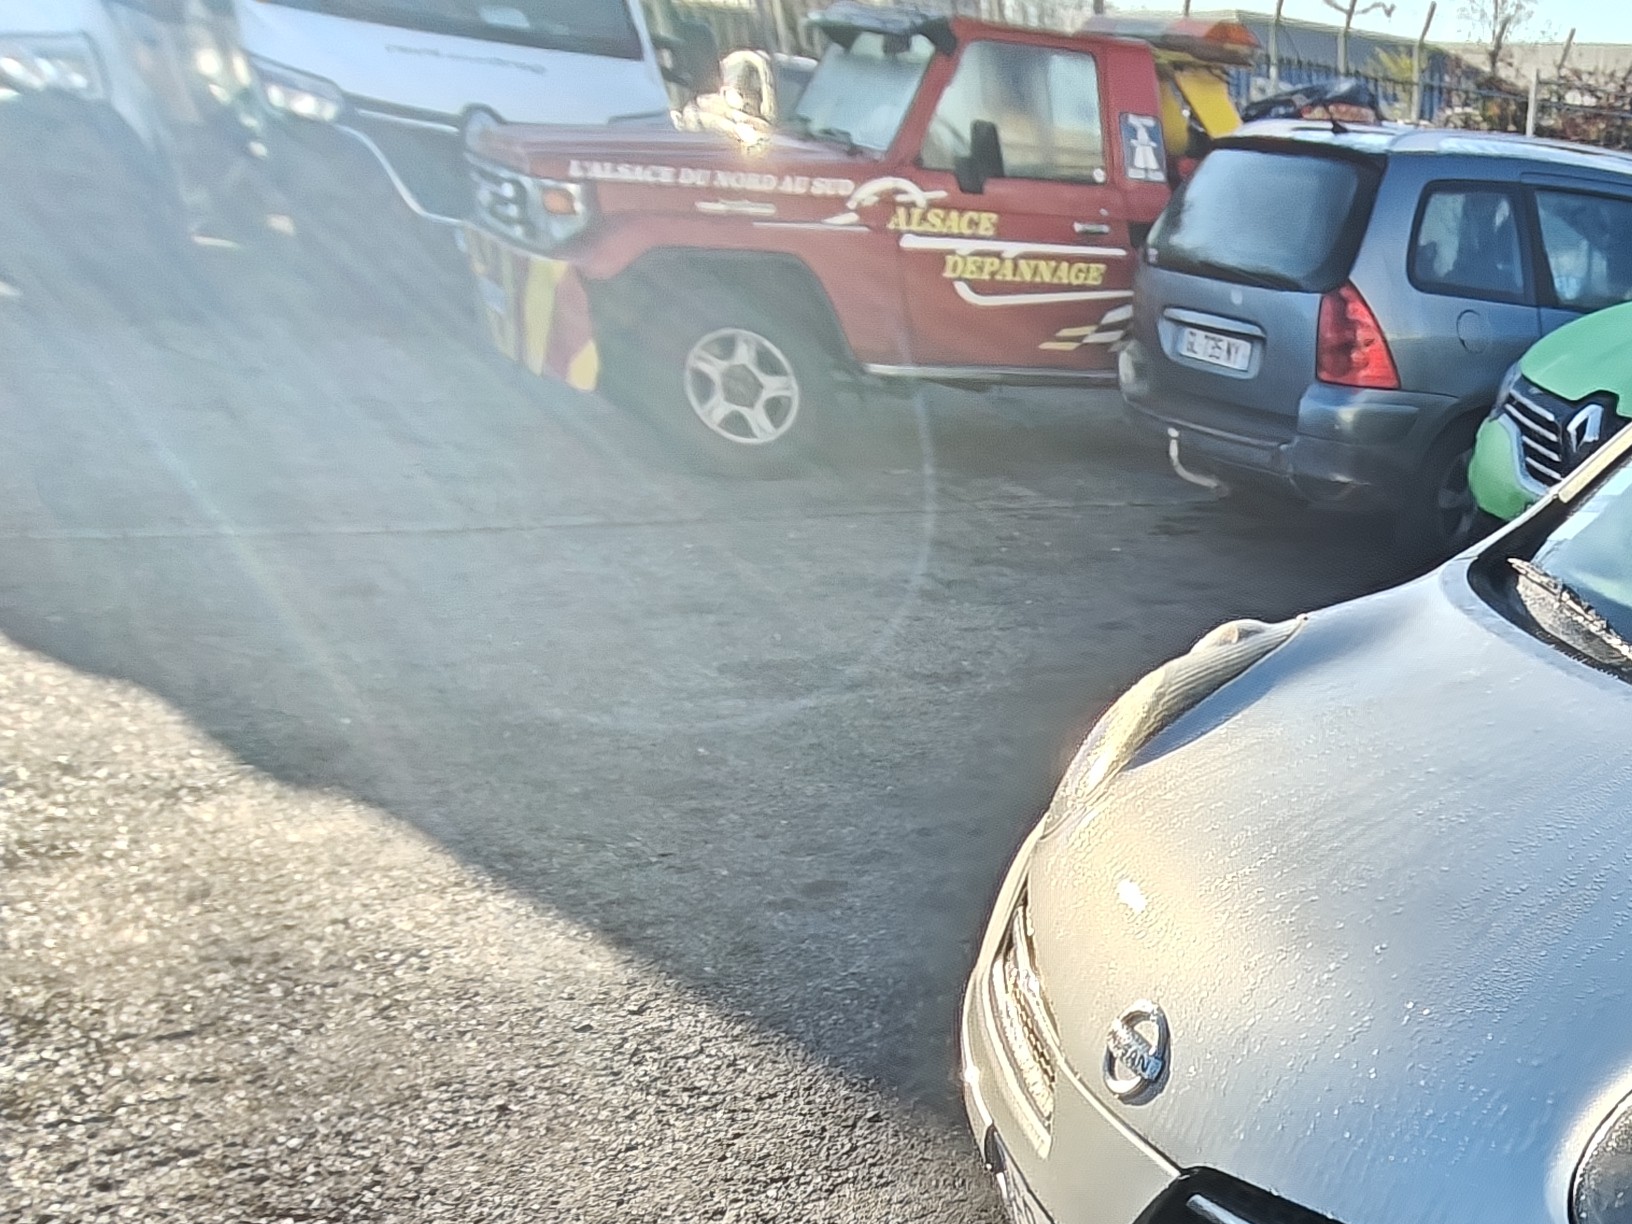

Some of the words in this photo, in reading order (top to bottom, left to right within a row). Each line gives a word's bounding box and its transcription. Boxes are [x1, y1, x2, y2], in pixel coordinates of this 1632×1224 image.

[679, 166, 712, 186] DU
[714, 168, 779, 192] NORD
[779, 174, 810, 195] AU
[811, 177, 856, 197] SUD
[886, 206, 999, 236] ALSACE
[943, 254, 1107, 286] DEPANNAGE
